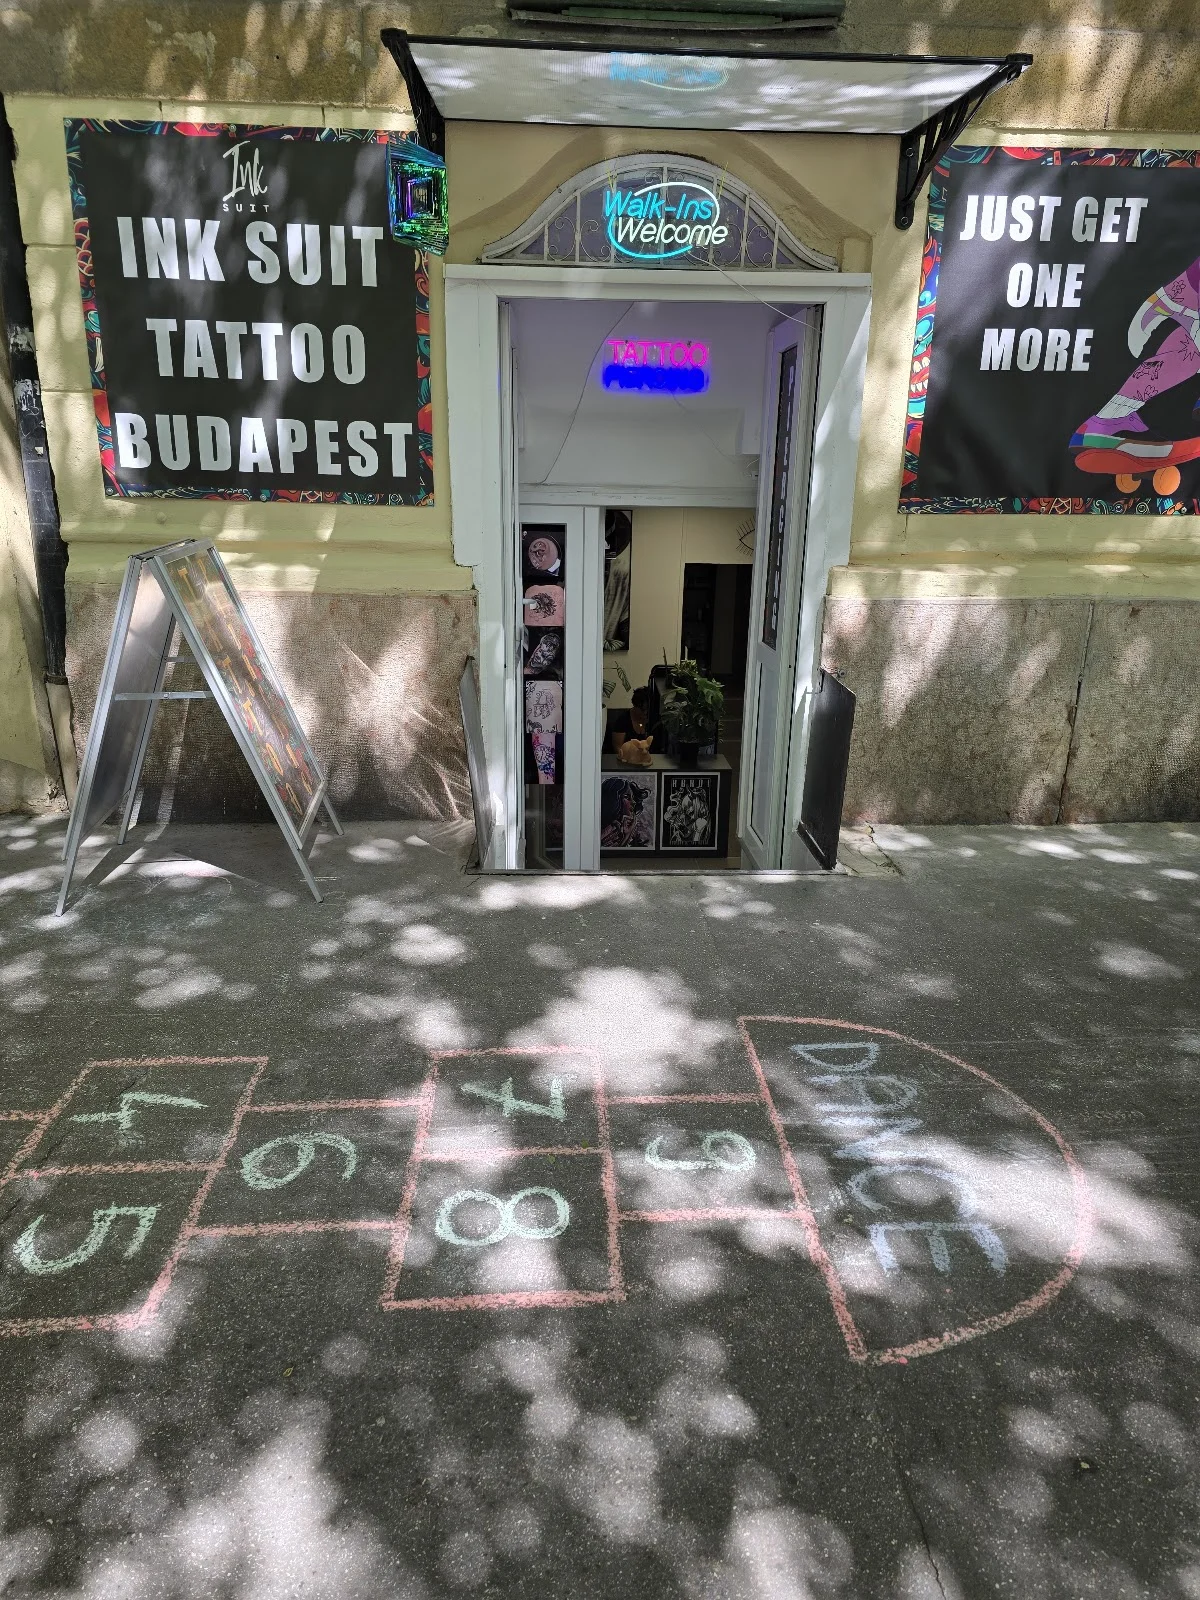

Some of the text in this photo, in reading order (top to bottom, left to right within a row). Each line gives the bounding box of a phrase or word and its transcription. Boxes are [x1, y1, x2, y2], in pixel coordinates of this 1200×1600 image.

[222, 140, 268, 201] Ink
[222, 203, 270, 213] SUIT
[604, 190, 715, 221] Walk-Ins
[617, 216, 729, 246] Welcome
[959, 194, 1149, 243] JUST GET
[116, 216, 384, 287] INK SUIT
[1006, 262, 1086, 308] ONE
[146, 317, 366, 385] TATTOO
[607, 340, 707, 367] TATTOO
[979, 327, 1095, 372] MORE
[114, 412, 413, 478] BUDAPEST
[771, 365, 794, 631] PIERCING
[460, 1074, 568, 1122] 7
[791, 1042, 1008, 1277] DANCE
[13, 1202, 162, 1275] 5
[435, 1186, 571, 1246] 8
